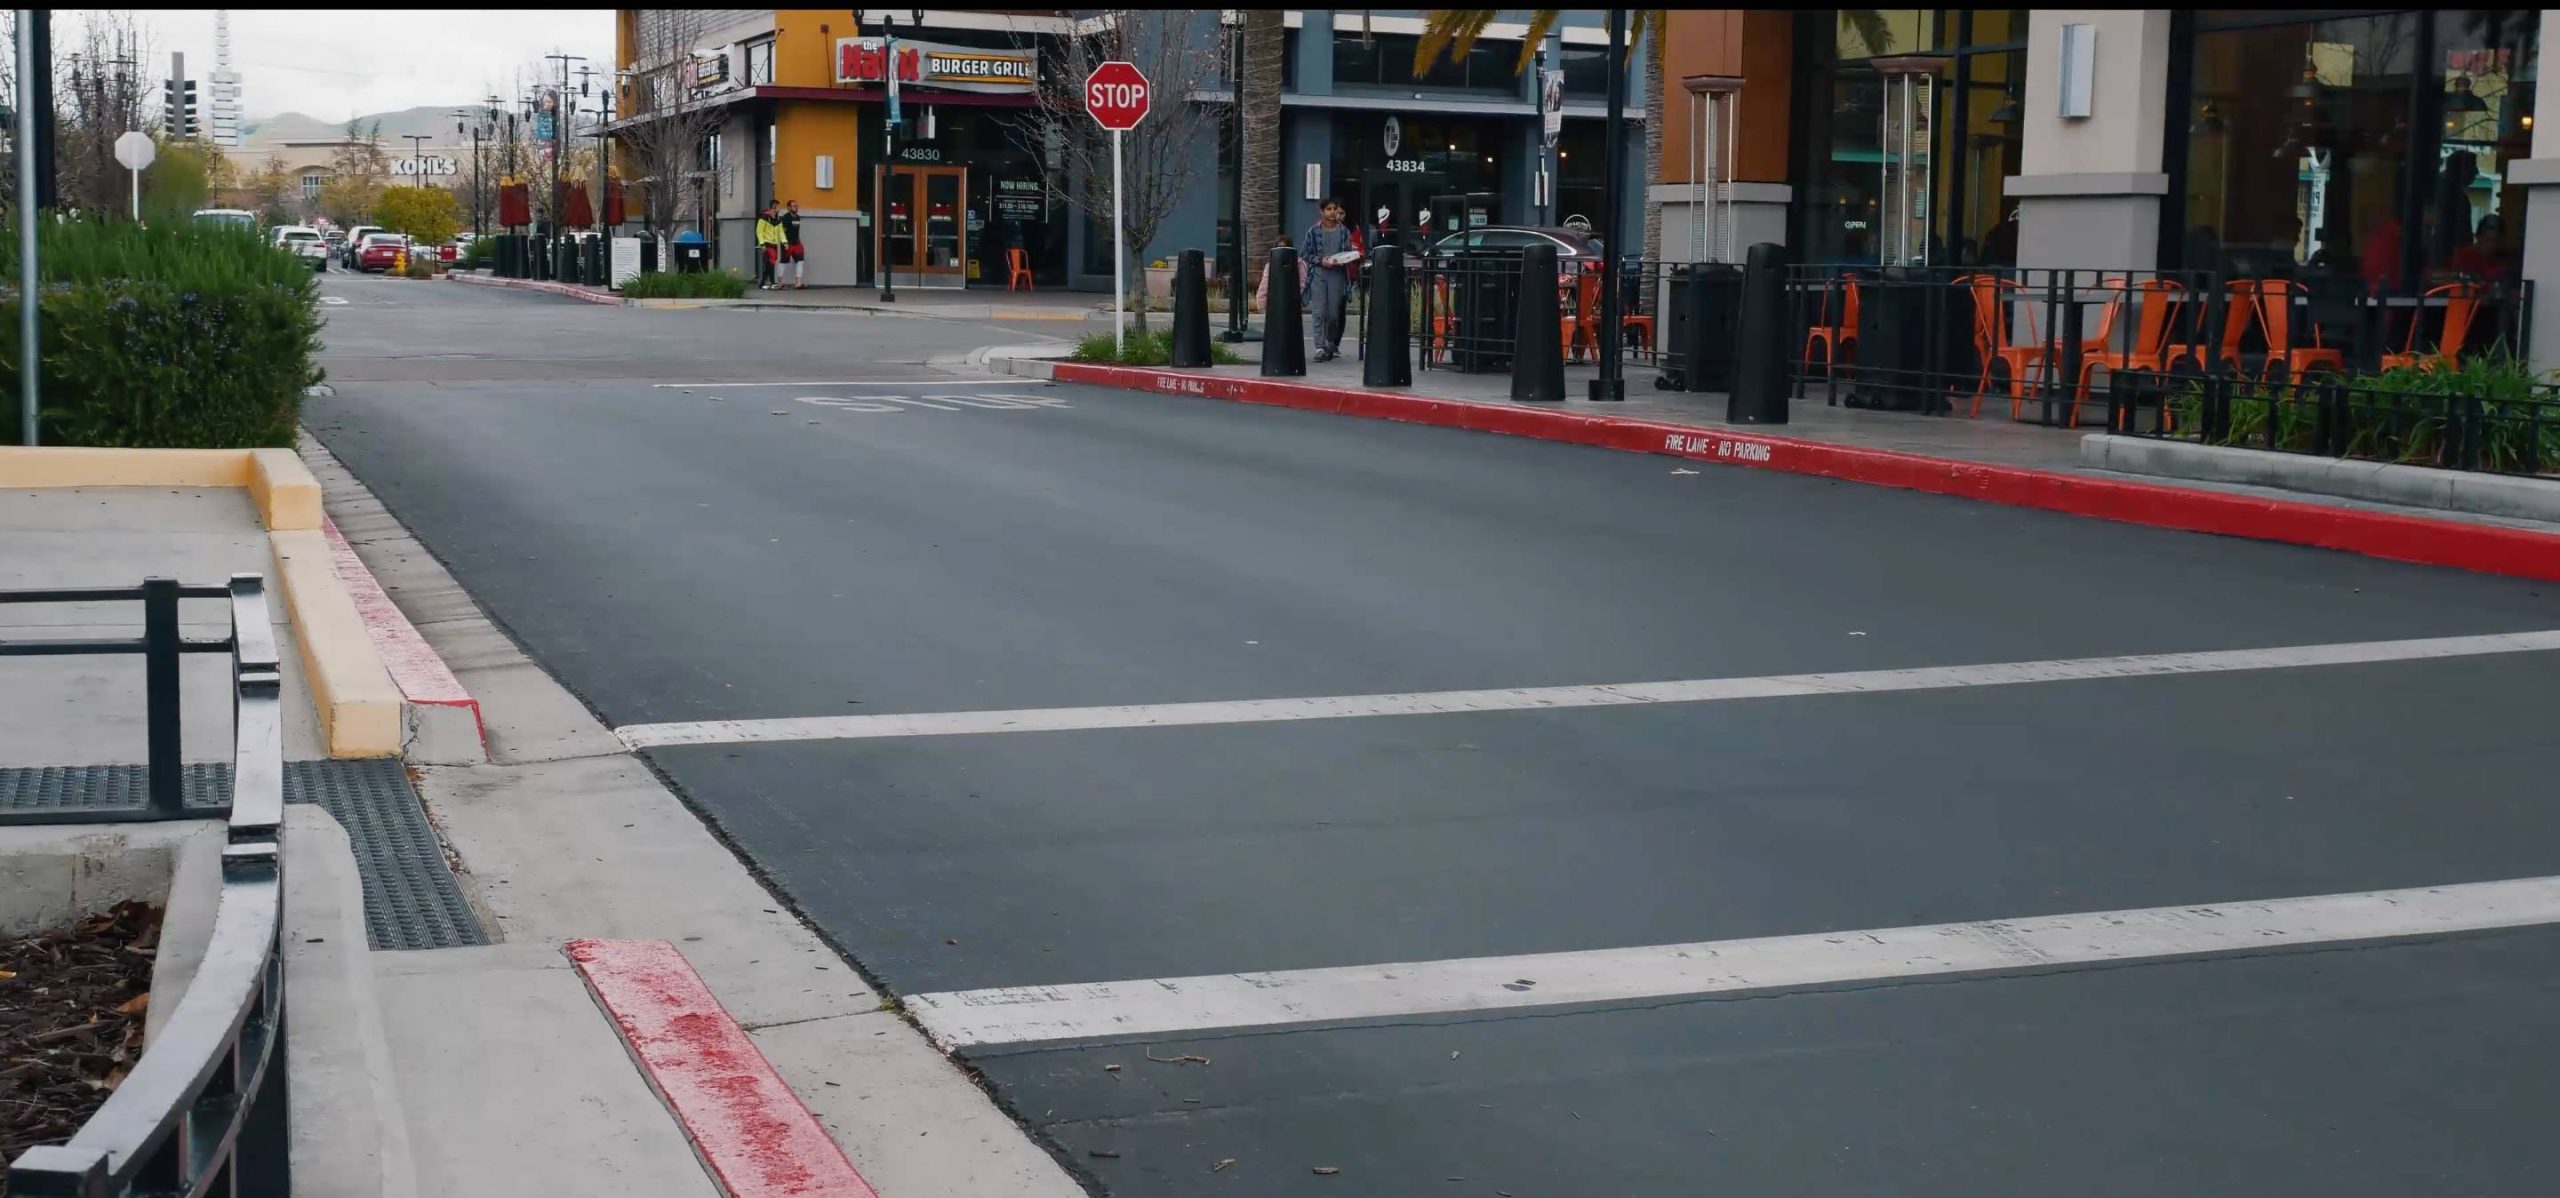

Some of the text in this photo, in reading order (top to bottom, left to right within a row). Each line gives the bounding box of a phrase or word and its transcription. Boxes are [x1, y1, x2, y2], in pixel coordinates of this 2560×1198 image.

[863, 40, 877, 50] the
[932, 59, 989, 75] BURGER
[1091, 83, 1145, 108] STOP
[901, 148, 940, 160] 43830
[390, 158, 457, 175] KOHL'S
[1386, 160, 1425, 172] 43834
[1000, 180, 1039, 191] NOW HIRING
[1844, 221, 1867, 229] OPEN
[795, 393, 1076, 413] STOP
[1665, 434, 1685, 451] FIRE
[1685, 436, 1710, 454] LANE
[1718, 440, 1732, 457] NO
[1733, 441, 1771, 462] PARKING
